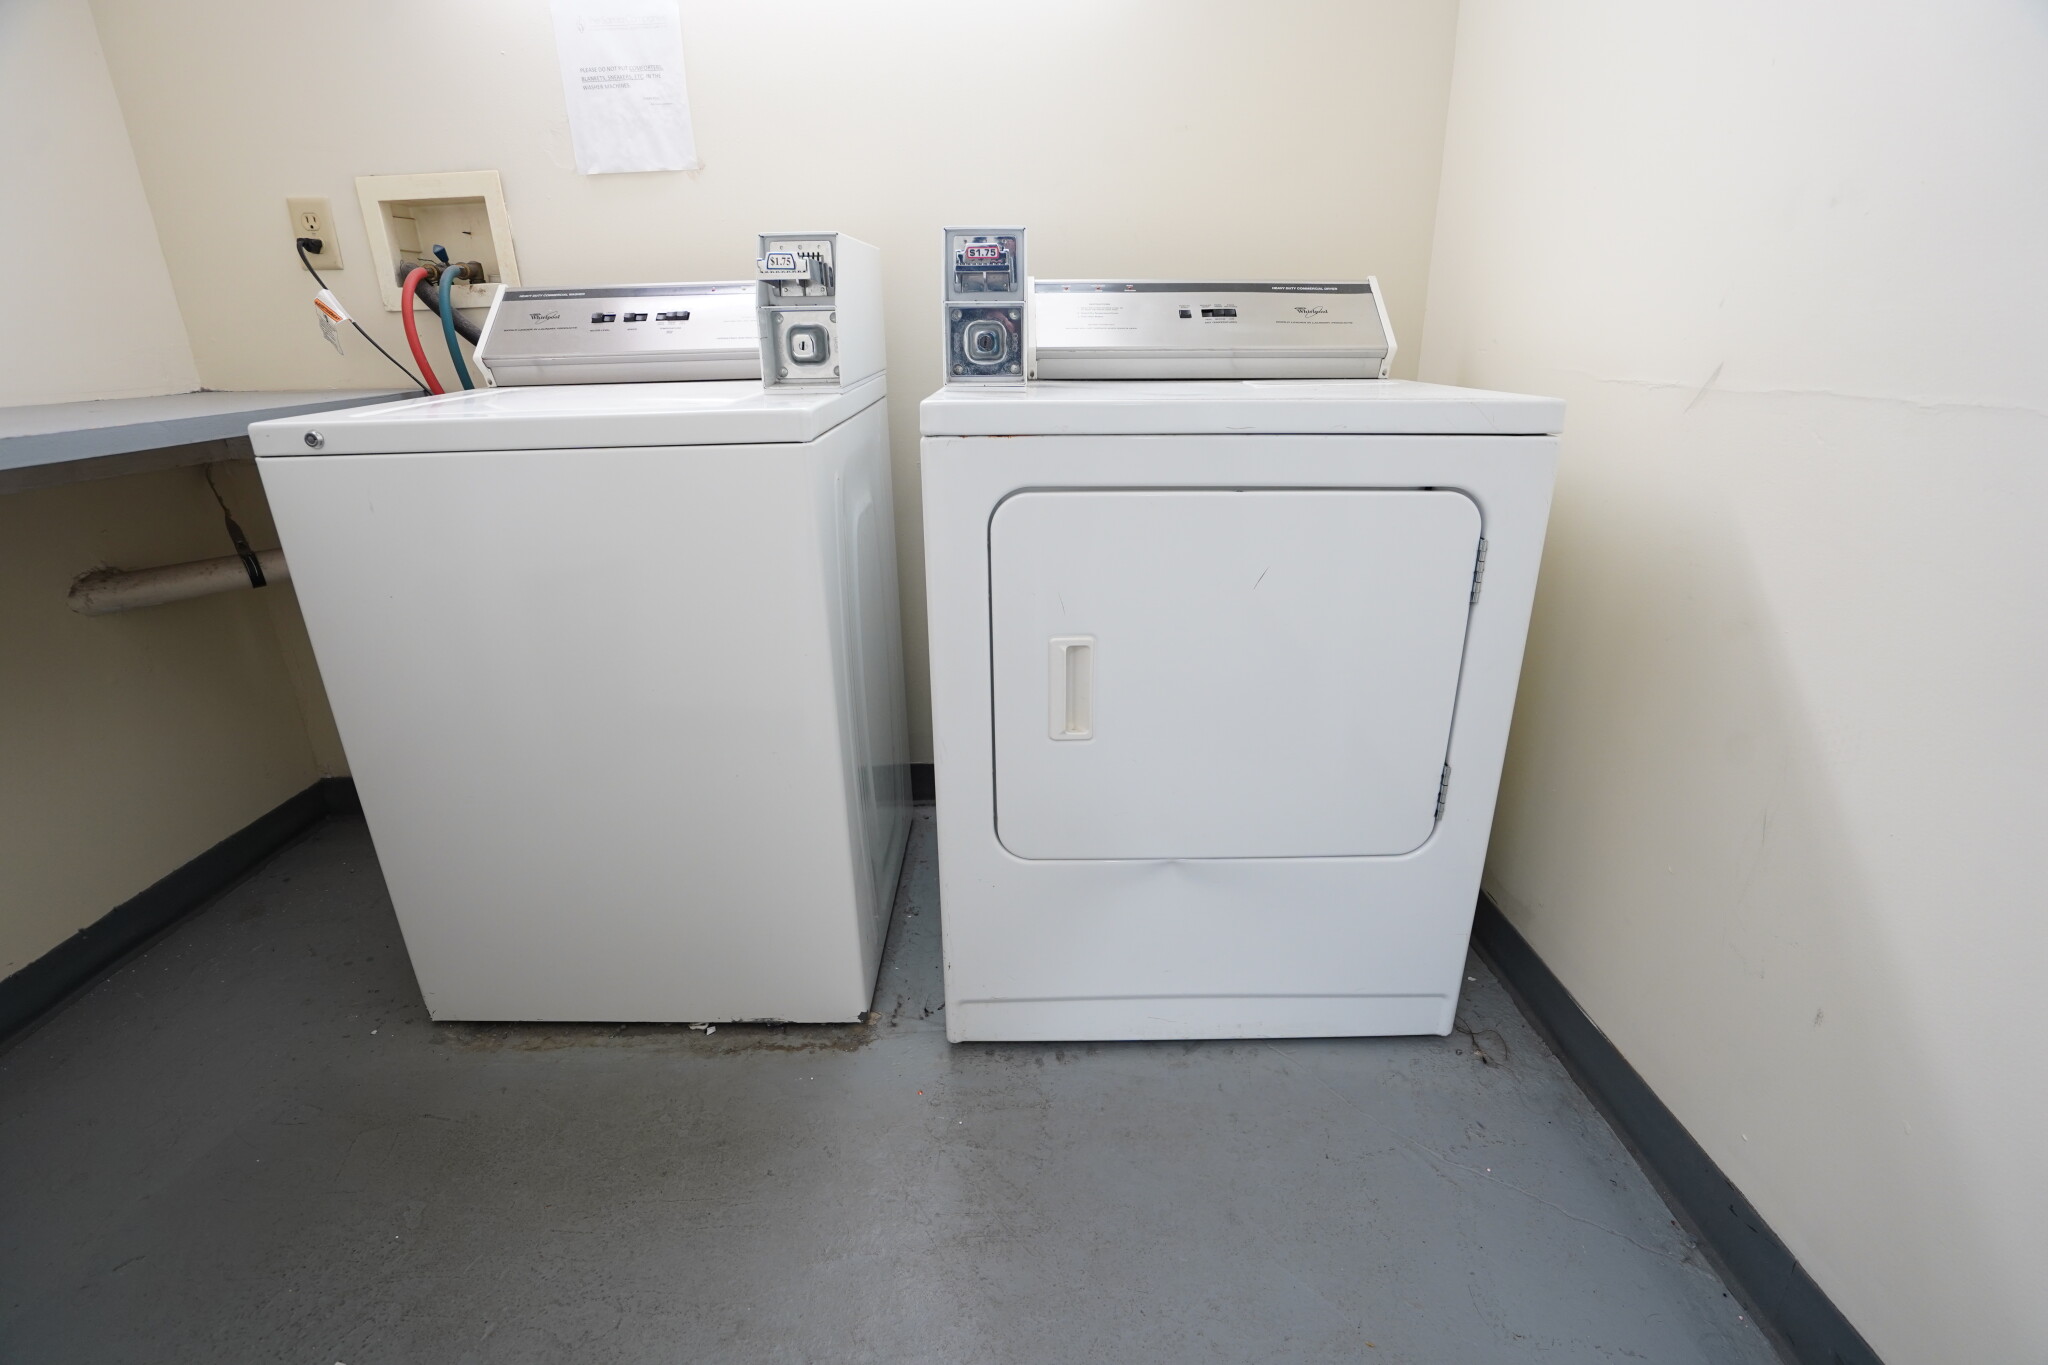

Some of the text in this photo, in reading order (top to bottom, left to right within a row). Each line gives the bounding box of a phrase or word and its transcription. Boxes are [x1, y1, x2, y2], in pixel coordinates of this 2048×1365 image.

[770, 257, 791, 266] $1.75
[530, 313, 561, 321] Whirlpool
[1298, 308, 1328, 317] Whirlpool
